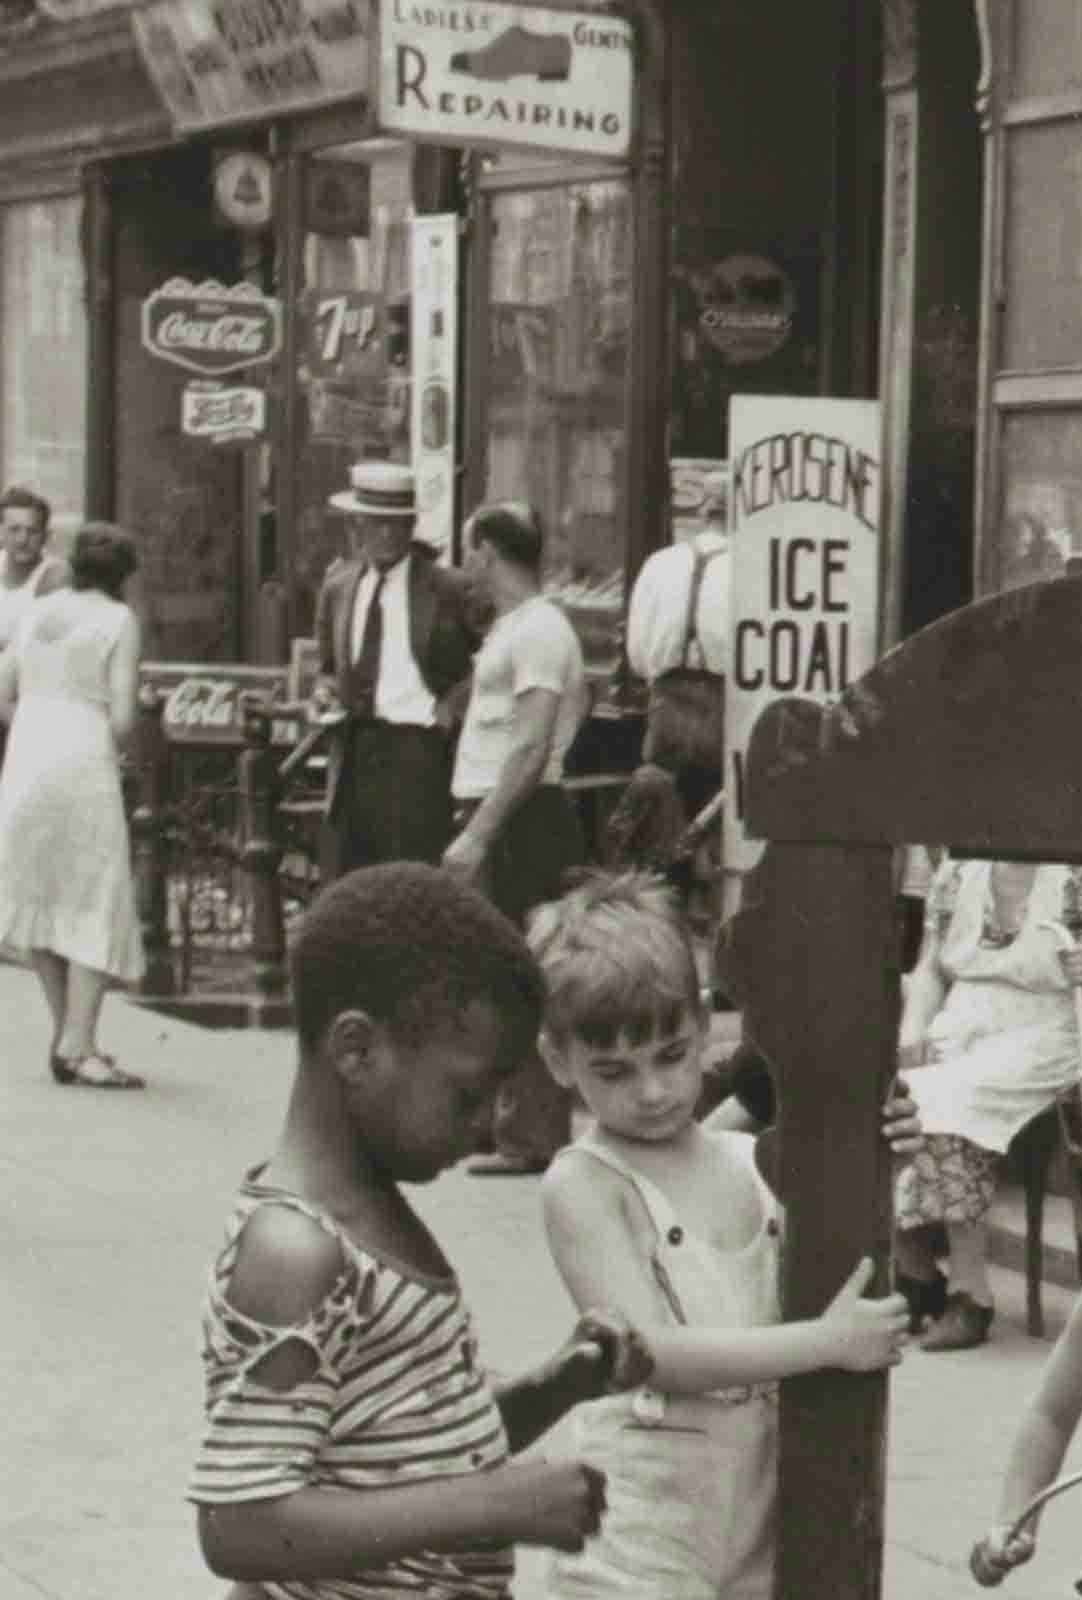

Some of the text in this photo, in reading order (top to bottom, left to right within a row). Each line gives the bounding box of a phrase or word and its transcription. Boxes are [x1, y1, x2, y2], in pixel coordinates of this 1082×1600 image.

[396, 43, 620, 135] REPAIRING
[734, 432, 880, 533] KEROSENE
[770, 537, 849, 612] ICE
